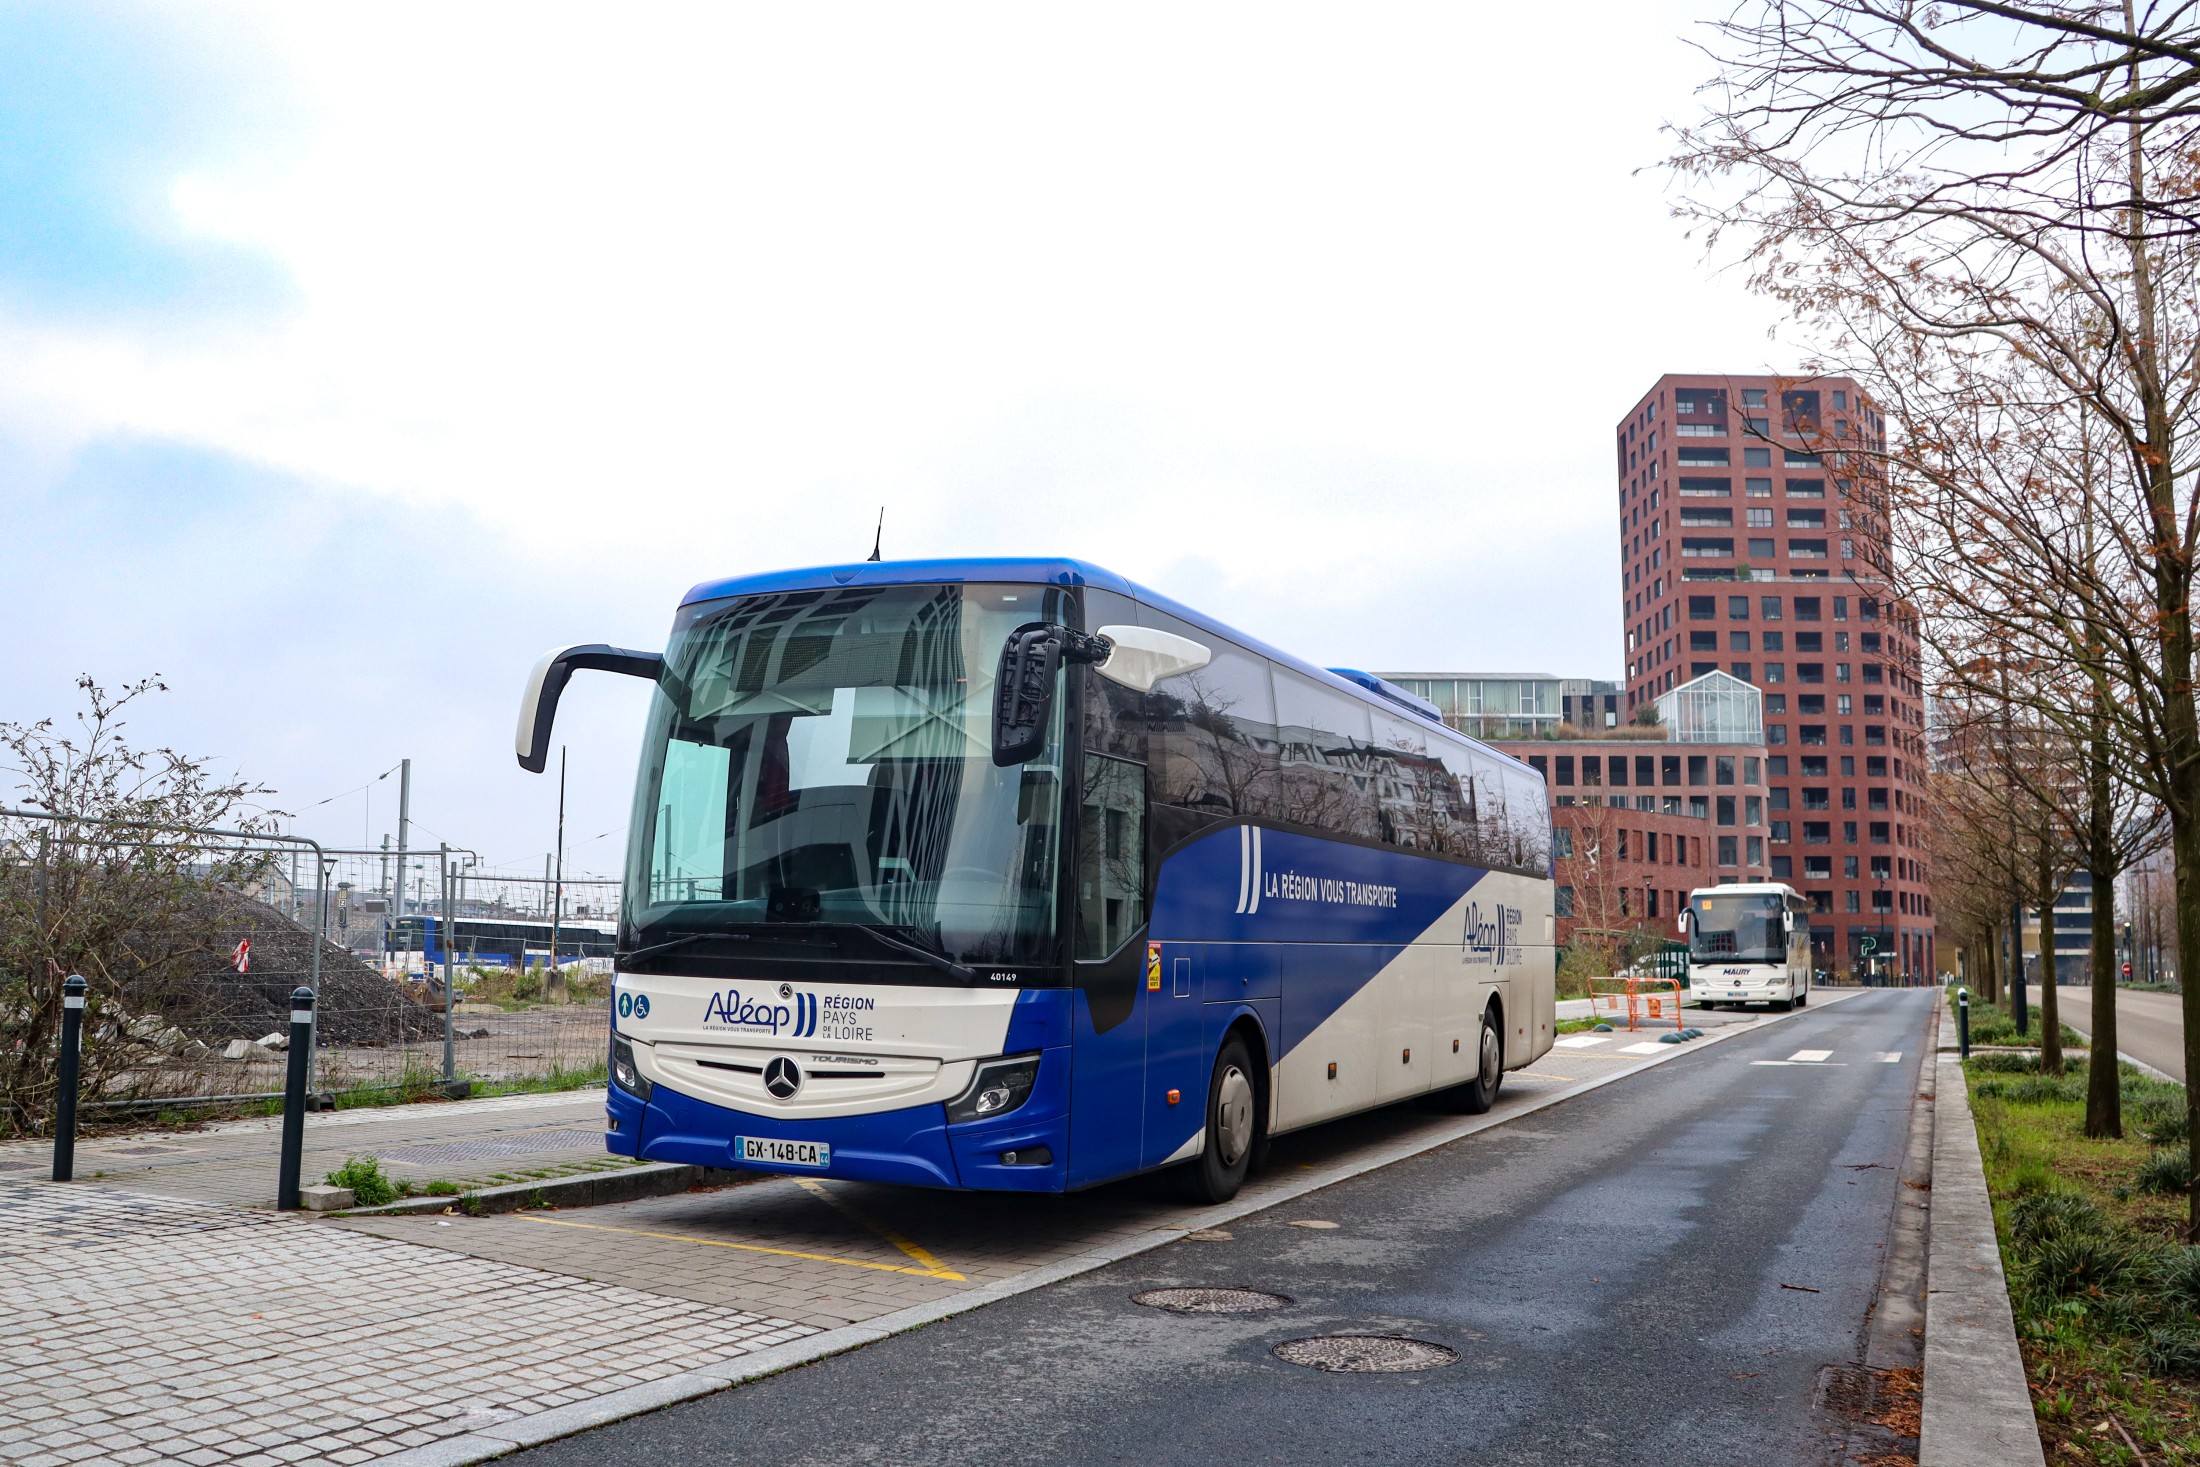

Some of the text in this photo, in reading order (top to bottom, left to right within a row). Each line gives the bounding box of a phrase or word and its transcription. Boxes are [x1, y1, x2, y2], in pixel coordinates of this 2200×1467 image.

[1265, 869, 1397, 908] LA RÉGION VOUS TRANSPORTE
[1506, 905, 1522, 925] RÉGION
[1462, 901, 1496, 966] Aléop
[990, 972, 1017, 982] 40149
[1723, 968, 1751, 976] MAURY
[823, 994, 875, 1011] RÉGION
[703, 989, 790, 1036] Aléop
[823, 1011, 857, 1025] PAYS
[709, 1024, 727, 1032] RÉGION
[740, 1027, 771, 1035] TRANSPORTE
[834, 1026, 873, 1041] LOIRE
[811, 1055, 879, 1066] TOURISMO
[747, 1140, 817, 1162] GX-148-CA
[820, 1156, 828, 1164] 44
